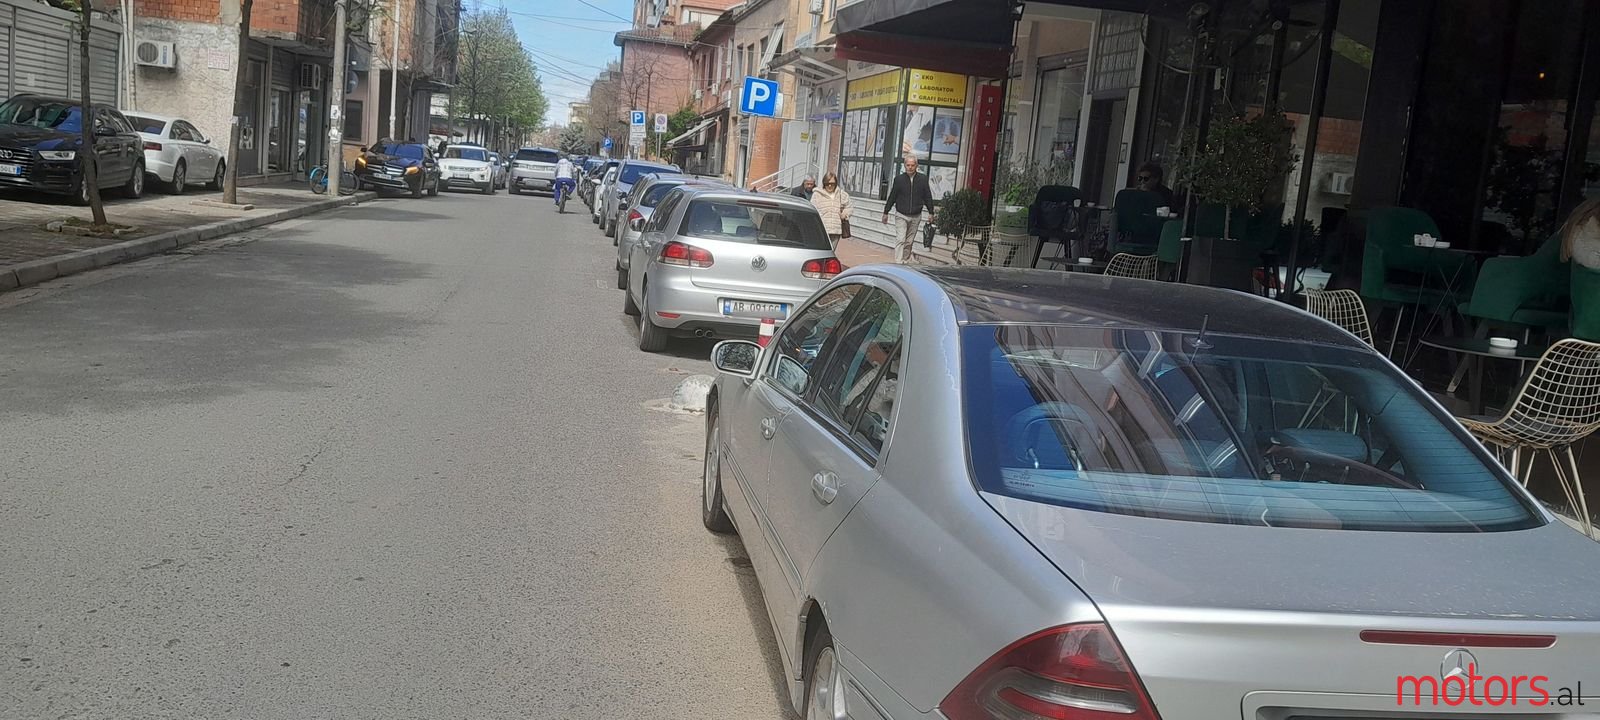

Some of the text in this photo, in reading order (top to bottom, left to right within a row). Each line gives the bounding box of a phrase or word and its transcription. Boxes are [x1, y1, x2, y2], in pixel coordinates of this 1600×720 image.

[748, 82, 771, 110] P
[918, 94, 964, 104] GRAFI DIGITALE
[984, 96, 994, 128] BAR
[634, 113, 642, 123] P
[604, 139, 611, 147] P
[733, 301, 745, 312] AB
